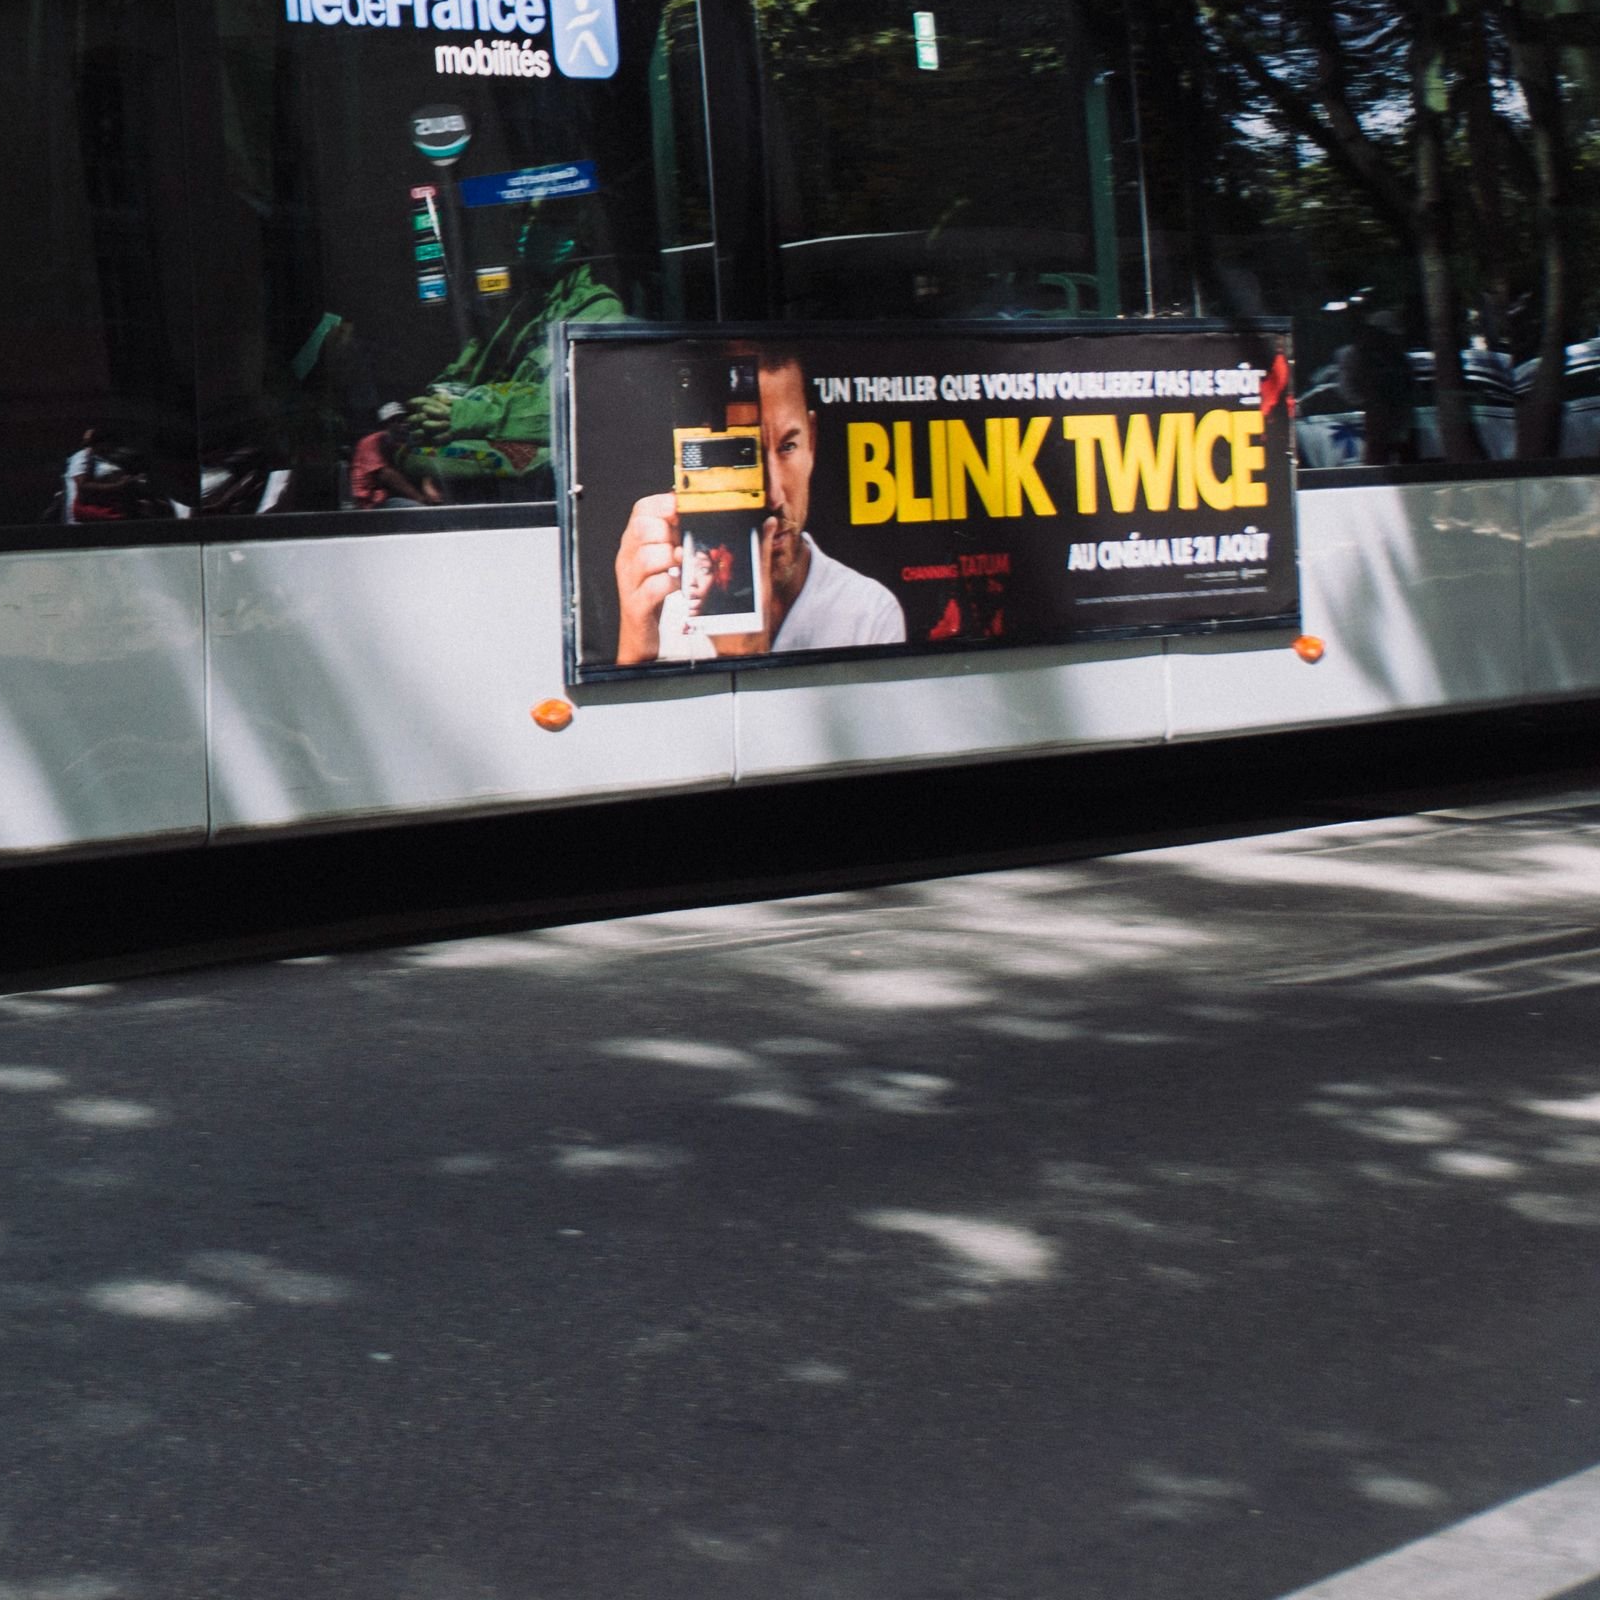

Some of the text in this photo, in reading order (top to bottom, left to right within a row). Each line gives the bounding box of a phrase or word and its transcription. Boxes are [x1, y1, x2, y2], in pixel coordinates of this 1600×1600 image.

[435, 40, 551, 79] mobilités
[854, 376, 938, 403] THRILLER
[940, 374, 982, 401] QUE
[982, 372, 1036, 400] VOUS
[1154, 370, 1190, 398] PAS
[1191, 369, 1214, 397] DE
[847, 408, 1269, 525] BLINK TWICE
[901, 553, 1011, 582] CHANNING TATUM
[1067, 542, 1097, 571] AU
[1171, 537, 1194, 566] LE
[1194, 536, 1216, 564] 21
